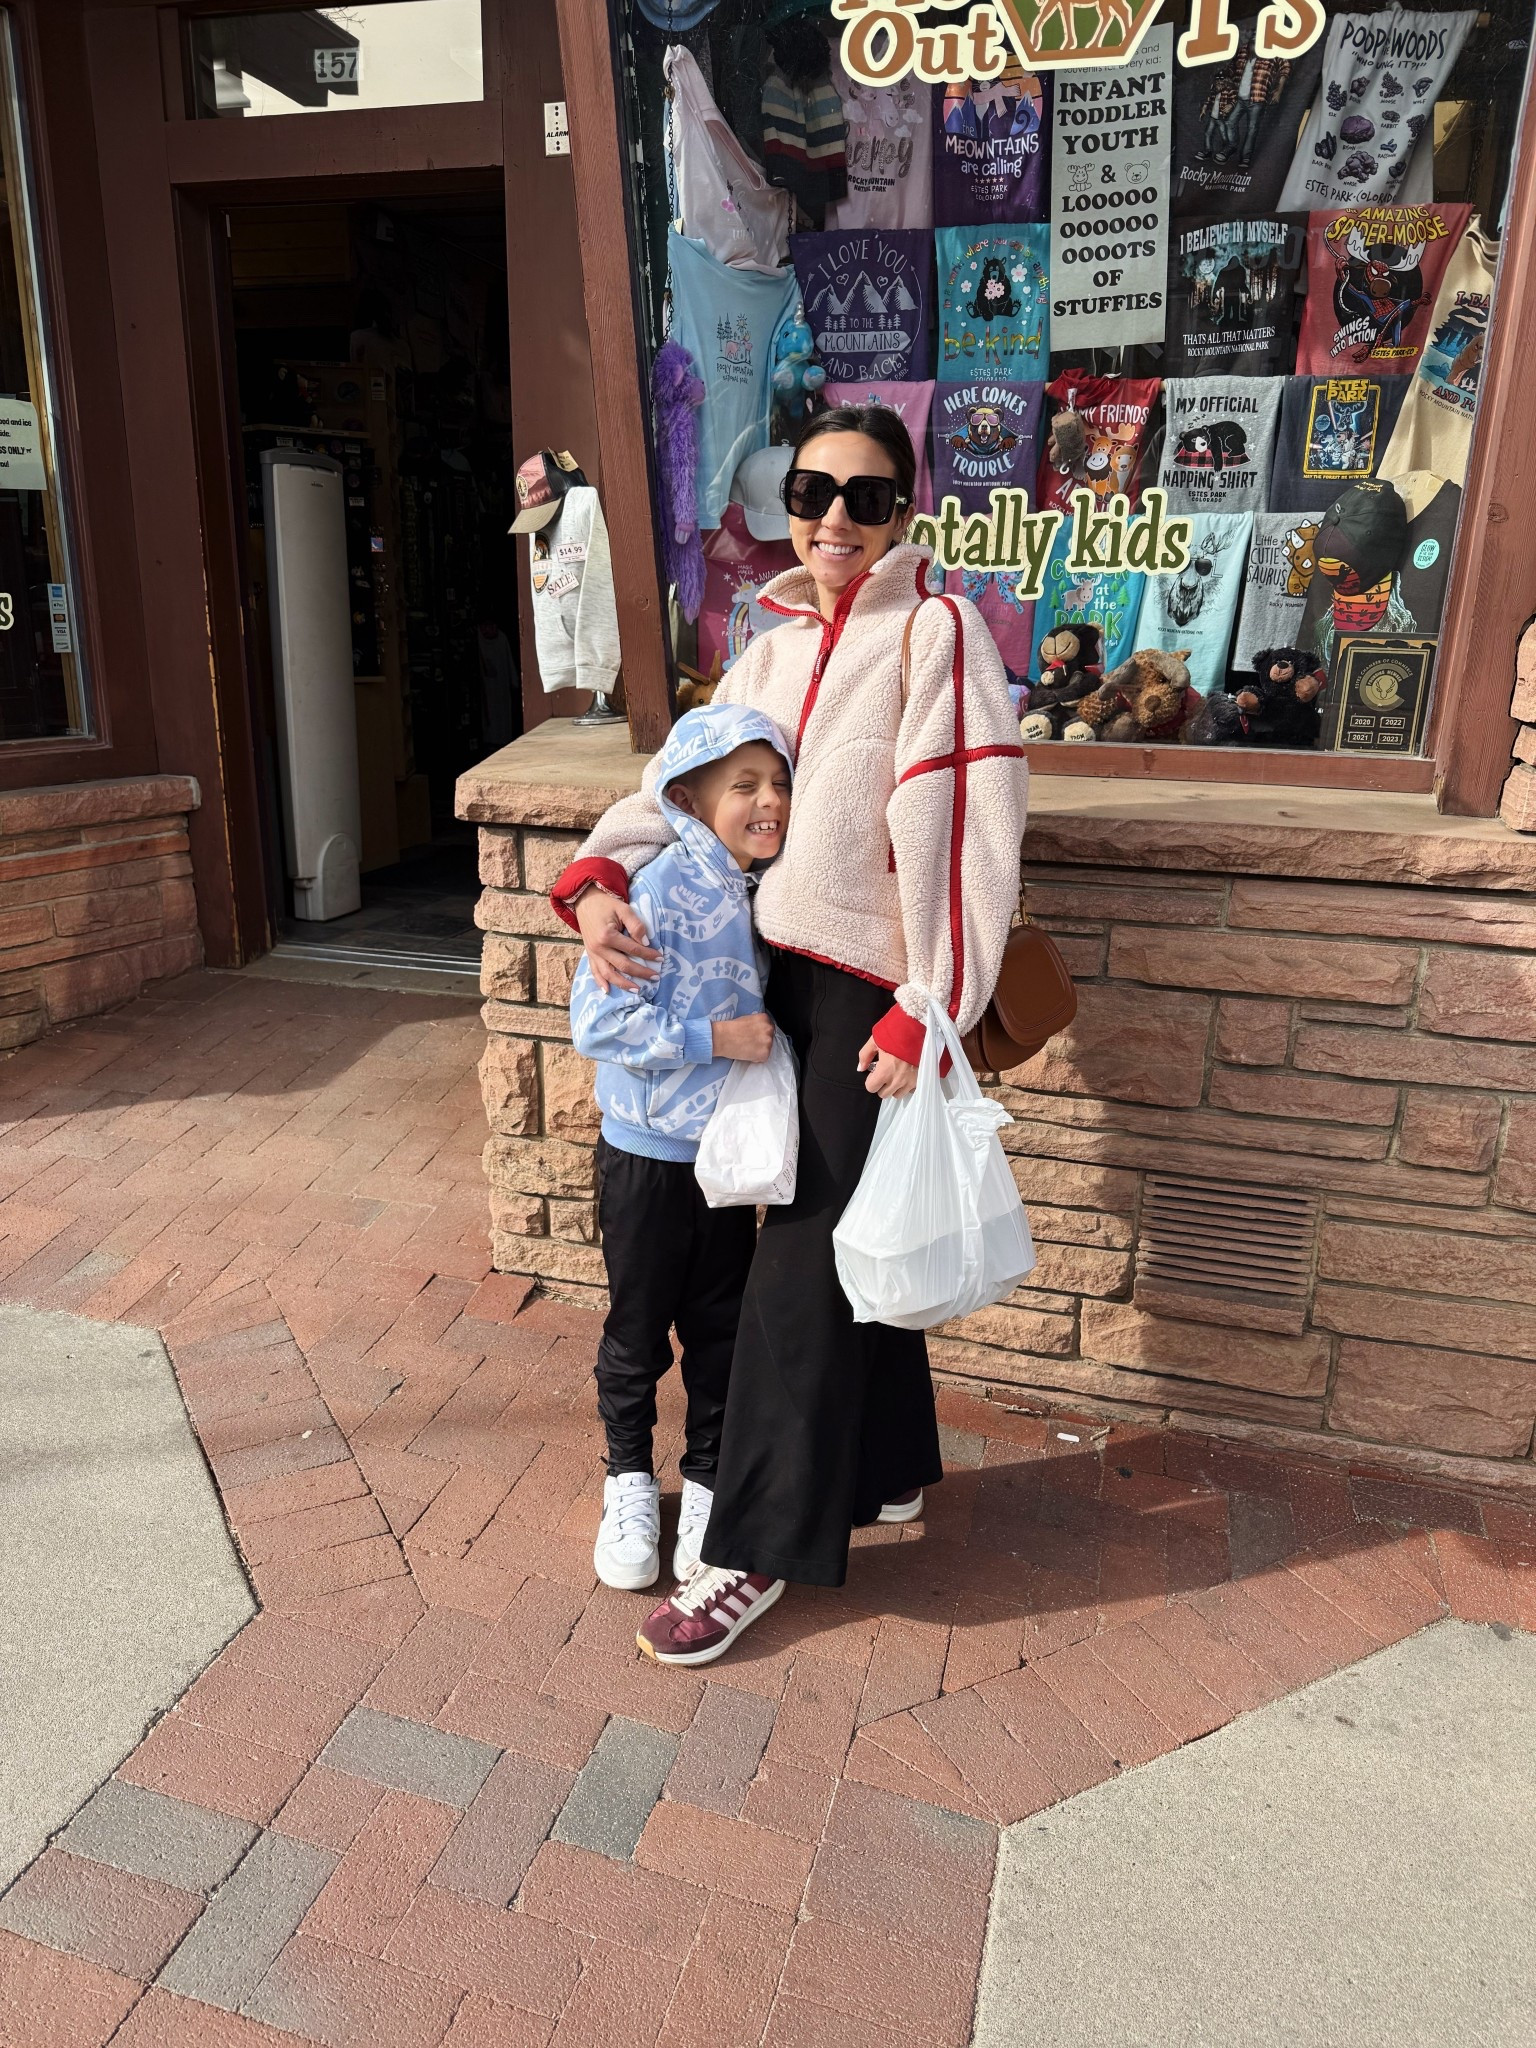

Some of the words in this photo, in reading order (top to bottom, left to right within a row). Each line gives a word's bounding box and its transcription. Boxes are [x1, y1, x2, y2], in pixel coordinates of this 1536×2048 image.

[848, 9, 999, 79] Out
[1141, 43, 1160, 54] and
[1340, 20, 1386, 58] POOP
[1391, 28, 1448, 61] WOODS
[317, 52, 358, 79] 157
[1145, 55, 1162, 65] kid:
[1060, 72, 1166, 103] INFANT
[1057, 99, 1167, 127] TODDLER
[962, 124, 975, 136] the
[1062, 126, 1159, 155] YOUTH
[945, 133, 1040, 160] MEOWNTAINS
[961, 161, 979, 175] are
[982, 156, 1023, 178] calling
[1100, 166, 1118, 184] &
[1180, 166, 1211, 187] Rocky
[1209, 170, 1252, 187] Mountain
[971, 185, 989, 194] ESTES
[991, 184, 1008, 192] PARK
[1062, 186, 1158, 213] LOOOOO
[1229, 185, 1246, 193] PARK
[1305, 180, 1329, 198] ESTES
[1358, 206, 1430, 222] AMAZING
[1060, 213, 1159, 239] OOOOOO
[1180, 234, 1184, 255] I
[1186, 223, 1230, 254] BELIEVE
[1232, 222, 1244, 243] IN
[1247, 221, 1289, 245] MYSELF
[817, 263, 831, 280] I
[827, 239, 870, 271] LOVE
[877, 240, 908, 274] YOU
[1062, 240, 1156, 264] OOOOTS
[964, 239, 989, 259] where
[993, 237, 1007, 251] you
[1032, 261, 1050, 305] anything
[1093, 269, 1124, 287] OF
[1053, 292, 1163, 317] STUFFIES
[850, 318, 859, 328] TO
[862, 317, 874, 328] THE
[1333, 316, 1370, 342] SWINGS
[824, 332, 901, 351] MOUNTAINS
[944, 322, 976, 361] be
[985, 317, 1044, 365] kind
[1183, 333, 1207, 345] THATS
[1207, 332, 1221, 344] ALL
[1222, 330, 1242, 343] THAT
[1243, 326, 1276, 341] MATTERS
[1331, 340, 1346, 358] INTO
[1348, 328, 1377, 346] ACTION
[1187, 347, 1204, 357] ROCKY
[1204, 345, 1231, 356] MOUNTAIN
[1231, 344, 1256, 354] NATIONAL
[1255, 341, 1269, 351] PARK
[716, 362, 731, 377] ROCKY
[732, 364, 754, 378] MOUNTAIN
[820, 357, 854, 378] AND
[859, 353, 907, 381] BACK!
[970, 368, 991, 376] ESTES
[994, 368, 1013, 376] PARK
[1326, 389, 1368, 402] PARK
[1328, 379, 1369, 391] ESTES
[1433, 386, 1460, 404] AND
[943, 386, 979, 414] HERE
[981, 386, 1027, 415] COMES
[1175, 397, 1196, 414] MY
[1419, 389, 1434, 402] ROCKY
[1434, 399, 1461, 416] MOUNTAIN
[22, 418, 32, 426] ice
[1100, 404, 1150, 426] FRIENDS
[8, 446, 25, 455] ONLY
[952, 452, 1015, 478] TROUBLE
[1071, 493, 1188, 570] kids
[1256, 535, 1279, 547] Little
[559, 546, 583, 557] $14.99
[1250, 548, 1280, 565] CUTIE
[547, 570, 575, 596] SALE!
[1247, 565, 1288, 587] SAURUS
[1095, 584, 1109, 595] at
[1094, 596, 1117, 610] the
[1361, 660, 1381, 675] CHAMBER
[1391, 659, 1413, 676] COMMERCE
[1387, 670, 1402, 682] MEMBER
[678, 884, 709, 914] NIKE
